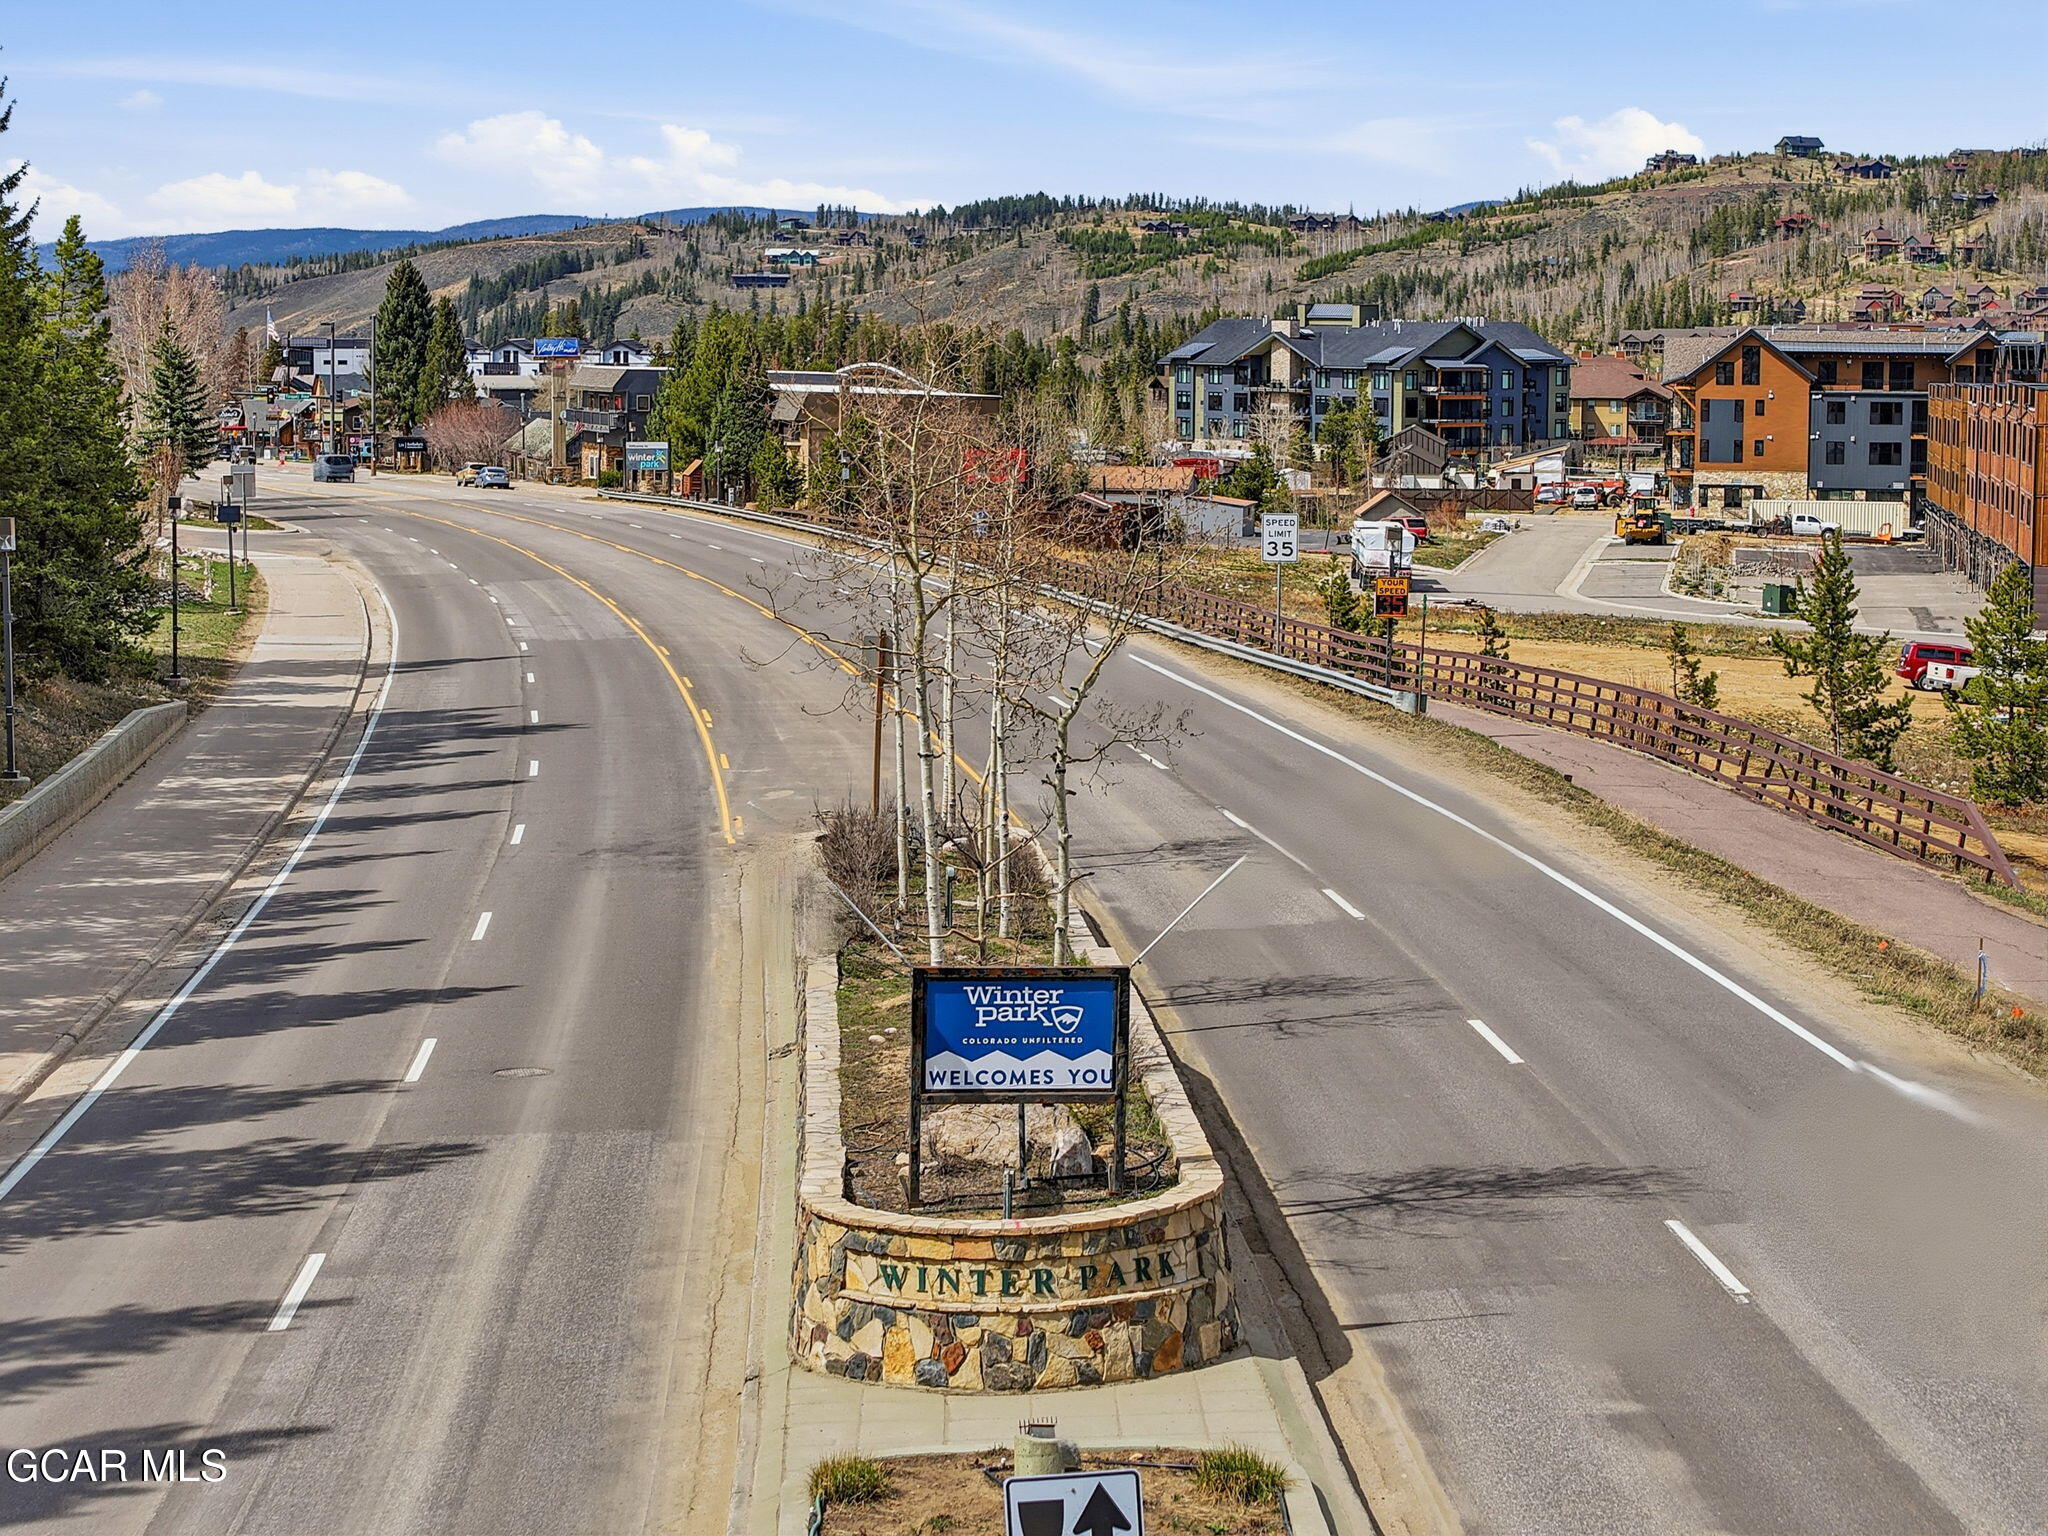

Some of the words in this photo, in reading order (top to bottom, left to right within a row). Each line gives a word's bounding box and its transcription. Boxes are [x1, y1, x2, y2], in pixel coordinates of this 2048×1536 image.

[628, 453, 655, 461] winter
[640, 460, 660, 469] park
[1265, 518, 1296, 527] SPEED
[1268, 530, 1292, 538] LIMIT
[1266, 541, 1294, 557] 35
[1381, 579, 1404, 587] YOUR
[1379, 587, 1406, 595] SPEED
[963, 986, 1064, 1005] Winter
[962, 1037, 1018, 1045] COLORADO
[1022, 1036, 1083, 1044] UNFILTERED
[929, 1069, 1054, 1086] WELCOMES
[1068, 1068, 1113, 1084] YOU
[879, 1263, 1057, 1297] WINTER
[1080, 1251, 1176, 1291] PARK
